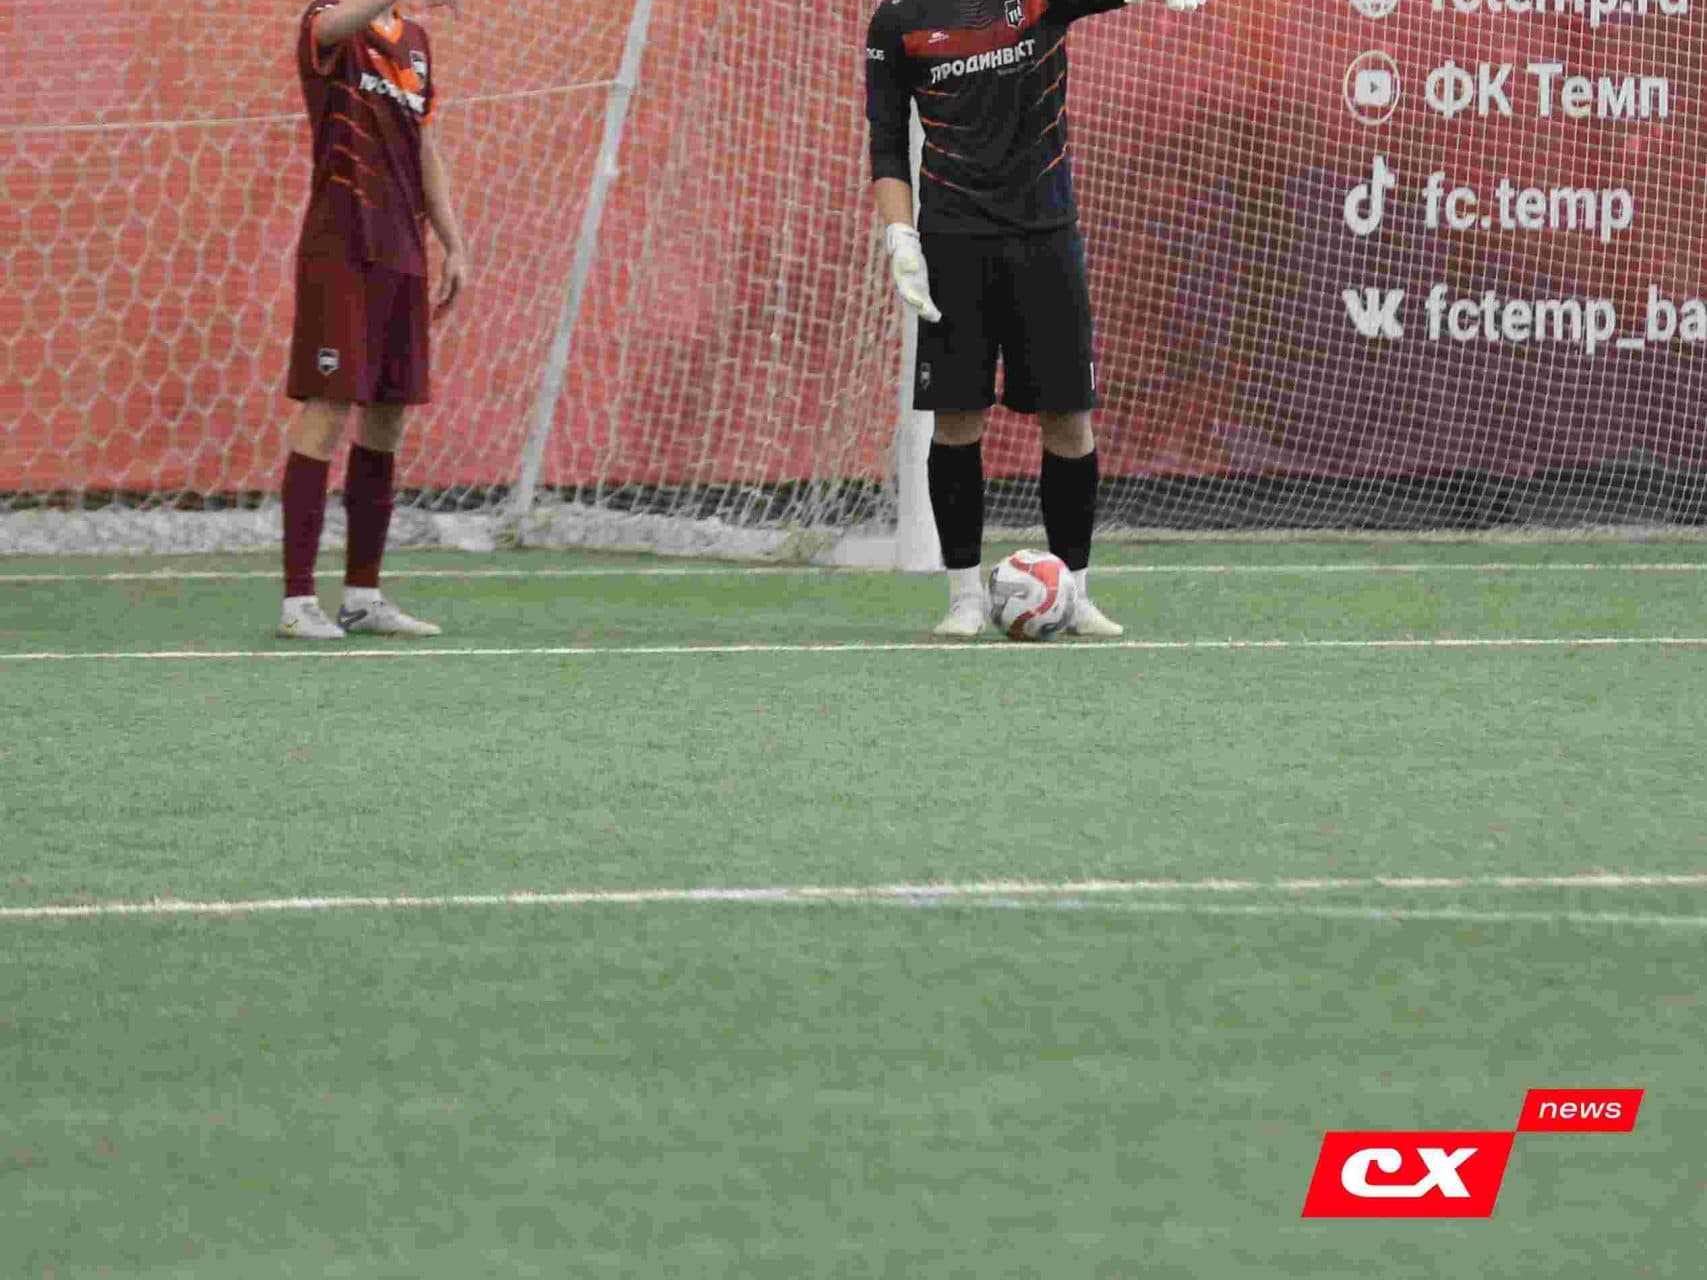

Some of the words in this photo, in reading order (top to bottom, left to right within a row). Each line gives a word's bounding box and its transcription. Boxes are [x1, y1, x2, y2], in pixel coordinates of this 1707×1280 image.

[1424, 60, 1513, 118] ФК
[1527, 62, 1669, 119] Темп
[1423, 171, 1634, 243] fc.temp
[1425, 283, 1707, 355] fctemp_ba
